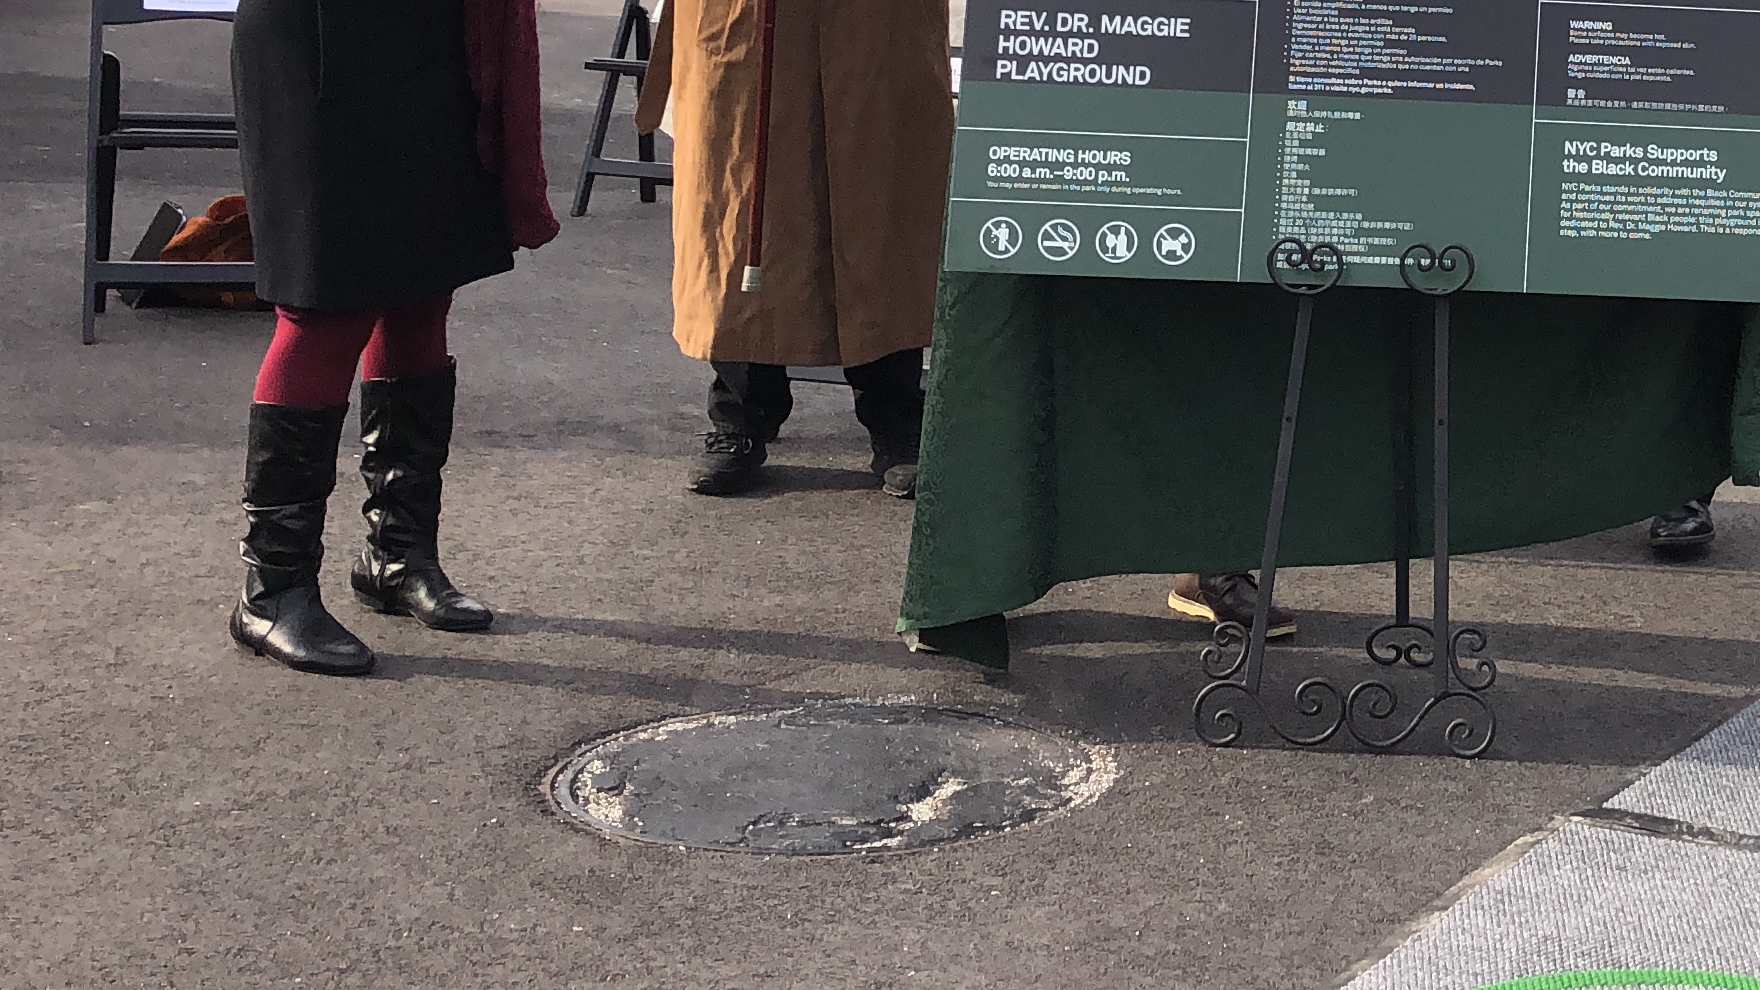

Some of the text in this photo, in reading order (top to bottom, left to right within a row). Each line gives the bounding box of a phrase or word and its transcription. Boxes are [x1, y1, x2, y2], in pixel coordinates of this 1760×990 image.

[999, 9, 1190, 37] REV. DR. MAGGIE
[1569, 20, 1612, 30] WARNING
[997, 35, 1099, 58] HOWARD
[1568, 53, 1630, 65] ADVERTENCIA
[995, 59, 1150, 85] PLAYGROUND
[989, 145, 1131, 165] OPERATING HOURS
[1564, 140, 1717, 164] NYC Parks Supports
[987, 163, 1130, 185] 6:00 a.m.–9:00 p.m.
[1561, 158, 1726, 183] the Black Community
[1081, 184, 1095, 192] park
[1131, 186, 1162, 194] operating
[1561, 182, 1578, 190] NYC
[1579, 183, 1601, 191] Parks
[1602, 184, 1628, 193] stands
[1638, 186, 1673, 196] solidarity
[1674, 187, 1691, 195] with
[1692, 188, 1705, 196] the
[1706, 189, 1727, 197] Black
[1577, 192, 1614, 201] continues
[1615, 194, 1625, 202] its
[1627, 194, 1645, 202] work
[1647, 195, 1655, 203] to
[1656, 196, 1686, 204] address
[1688, 197, 1724, 208] inequities
[1571, 201, 1588, 211] part
[1612, 203, 1663, 214] commitment,
[1690, 207, 1726, 217] renaming
[1727, 208, 1744, 218] park
[1559, 219, 1598, 228] dedicated
[1608, 221, 1624, 229] Rev.
[1626, 222, 1636, 230] Dr.
[1638, 222, 1665, 233] Maggie
[1667, 224, 1698, 232] Howard.
[1700, 225, 1715, 233] This
[1572, 210, 1614, 221] historically
[1615, 212, 1645, 221] relevant
[1647, 214, 1668, 222] Black
[1669, 215, 1697, 225] people:
[1698, 216, 1713, 224] this
[1714, 217, 1756, 227] playground
[1559, 228, 1578, 238] step,
[1580, 229, 1597, 237] with
